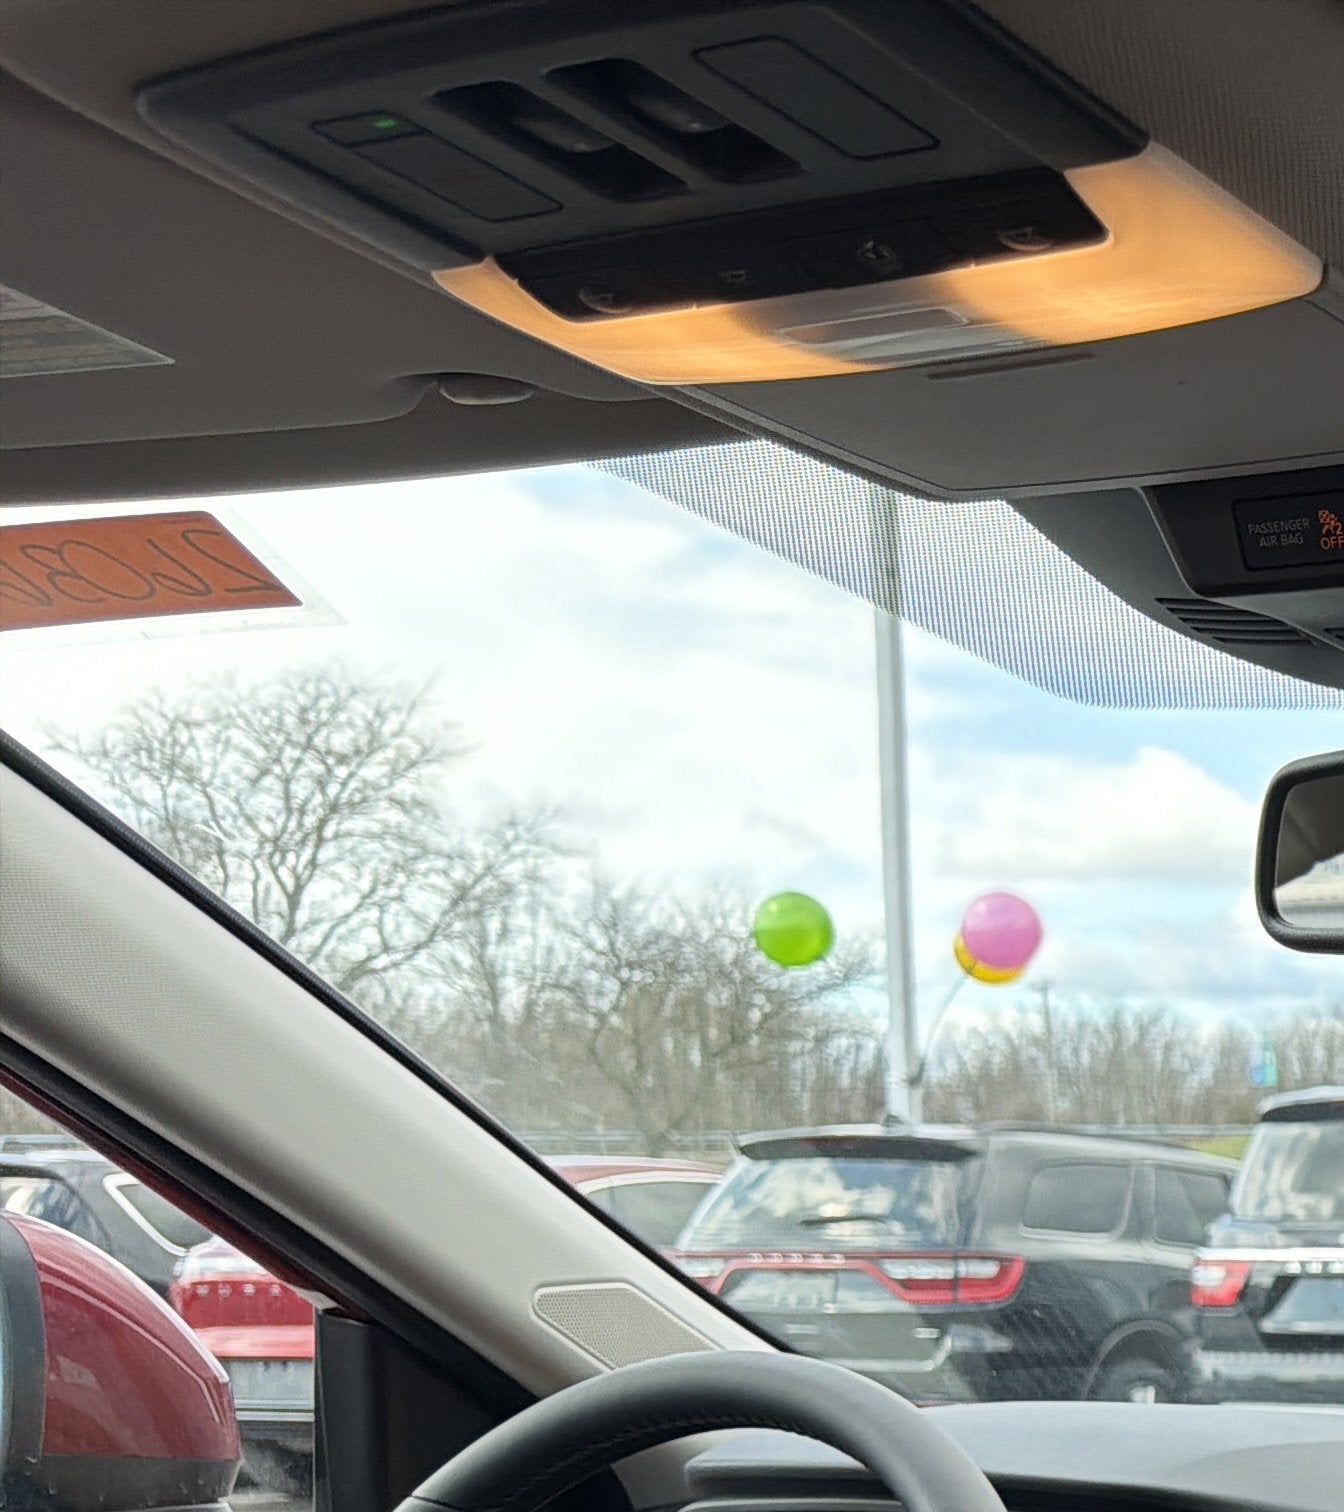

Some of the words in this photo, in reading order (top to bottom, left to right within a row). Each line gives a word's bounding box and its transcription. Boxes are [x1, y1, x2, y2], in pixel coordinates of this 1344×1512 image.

[1248, 518, 1310, 534] PASSENGER
[1260, 536, 1278, 548] AIR
[1280, 533, 1304, 545] BAG
[1320, 536, 1344, 549] OFF
